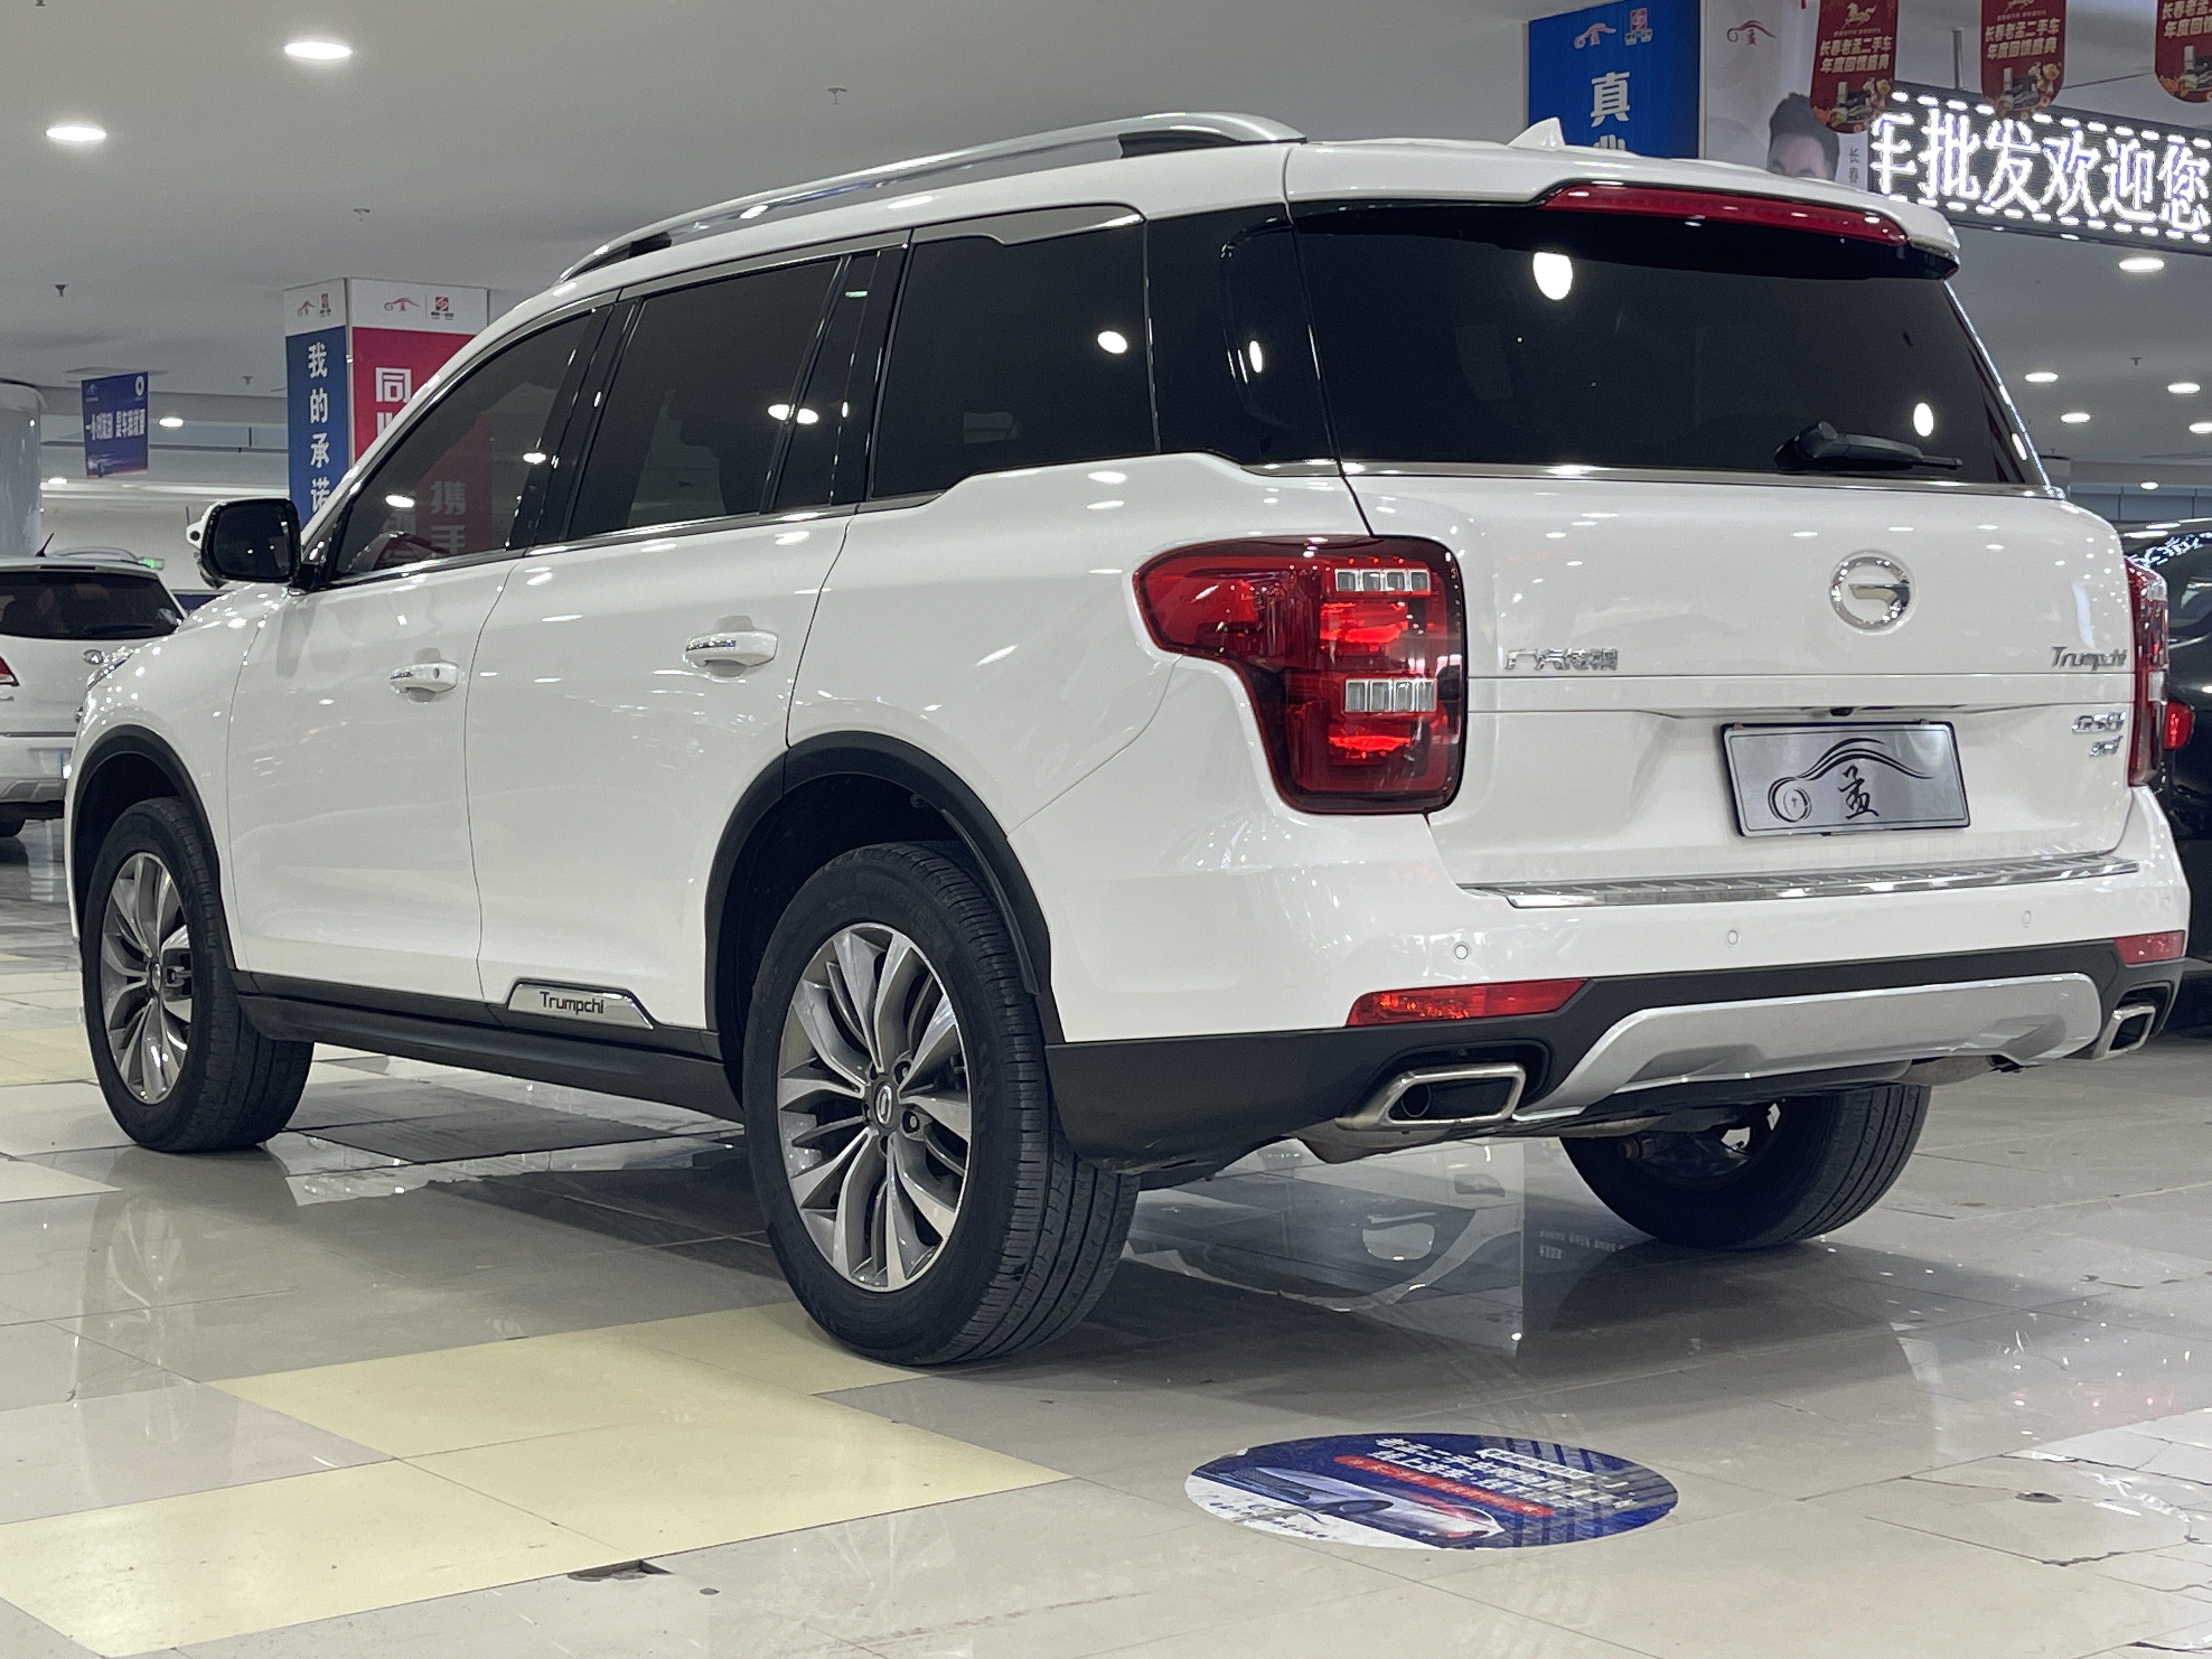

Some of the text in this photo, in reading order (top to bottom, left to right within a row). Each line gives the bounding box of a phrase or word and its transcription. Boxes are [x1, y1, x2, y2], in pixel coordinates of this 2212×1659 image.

[1985, 18, 2061, 42] 长春老孟二手车
[1820, 36, 1893, 56] 长春老孟二手车
[308, 342, 329, 512] 我的承诺
[540, 990, 604, 1015] Trumpchi
